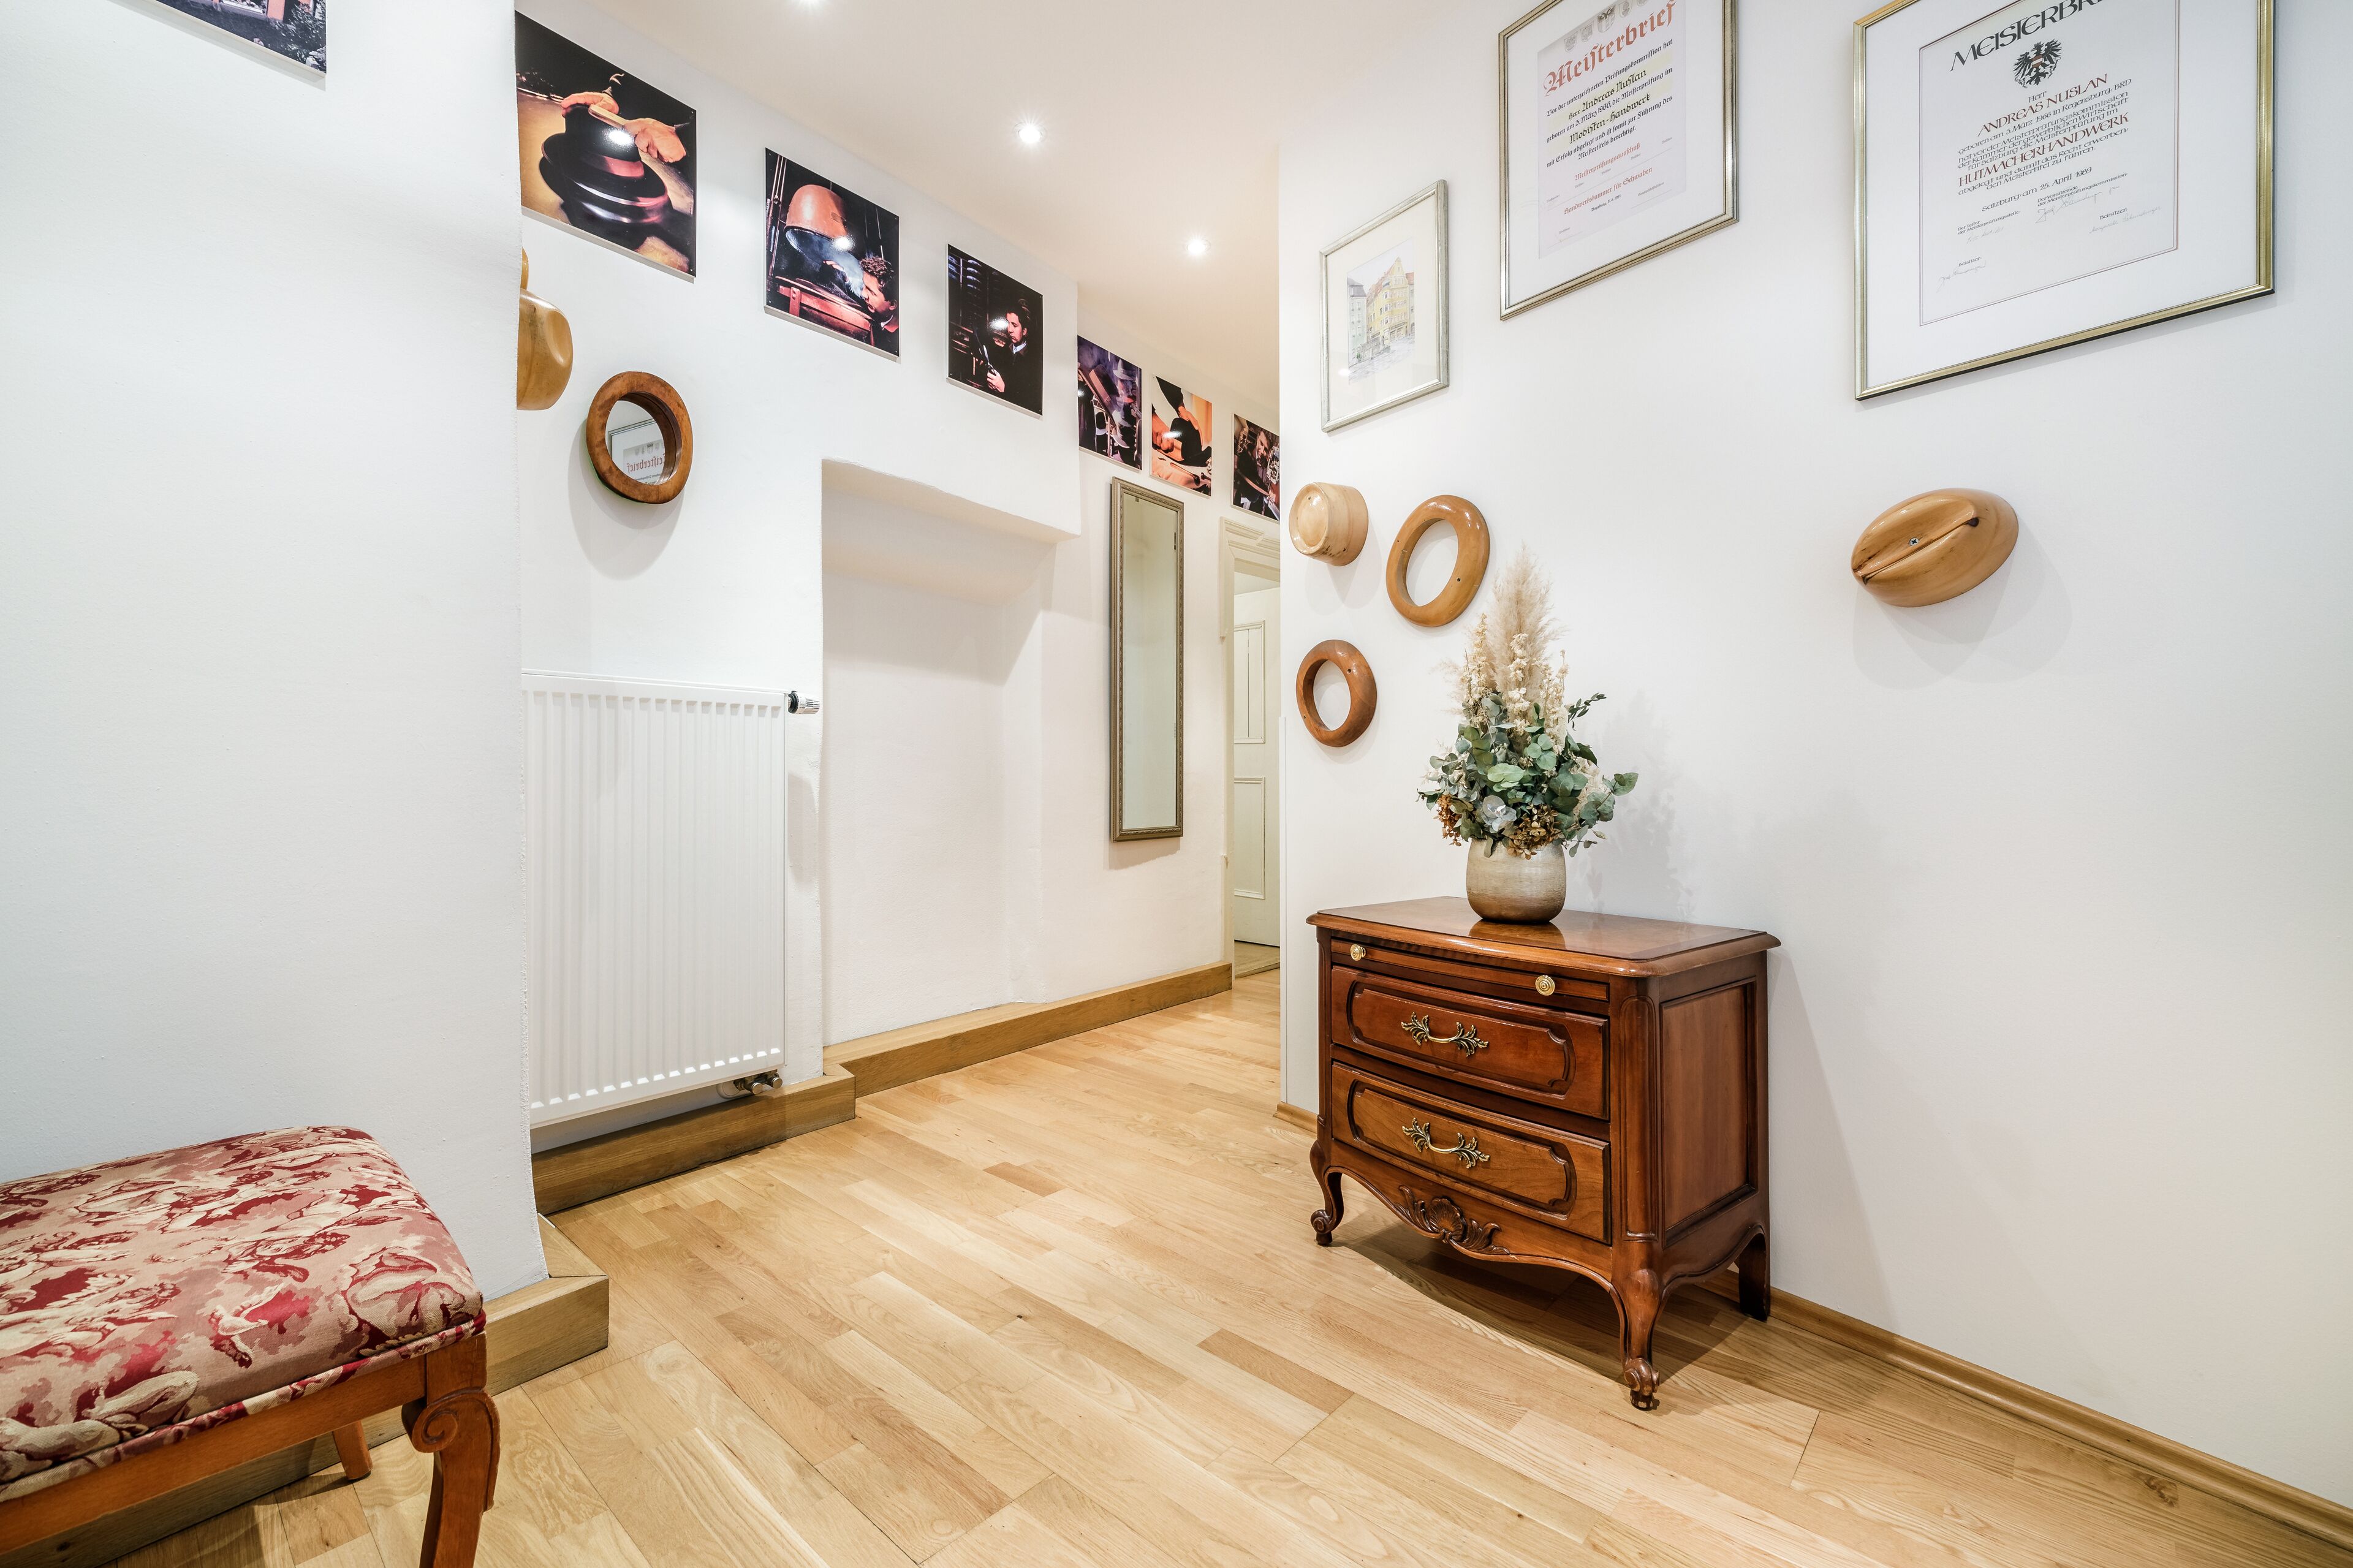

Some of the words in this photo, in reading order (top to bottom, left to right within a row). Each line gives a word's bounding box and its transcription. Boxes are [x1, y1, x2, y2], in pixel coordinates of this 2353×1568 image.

[1950, 0, 2103, 71] MEISTERBR
[1958, 138, 1988, 154] geboren
[1990, 132, 2003, 140] am
[2036, 111, 2051, 123] 1966
[2115, 78, 2131, 90] BRD
[1977, 101, 2043, 137] ANDREAS
[2047, 73, 2107, 108] NUSLAN
[2028, 91, 2047, 103] Herr
[1959, 112, 2128, 186] HUTMACHERHANDWERK
[1996, 170, 2012, 180] und
[2040, 154, 2057, 165] das
[2022, 187, 2037, 196] am
[2052, 173, 2071, 186] April
[2076, 167, 2091, 177] 1989
